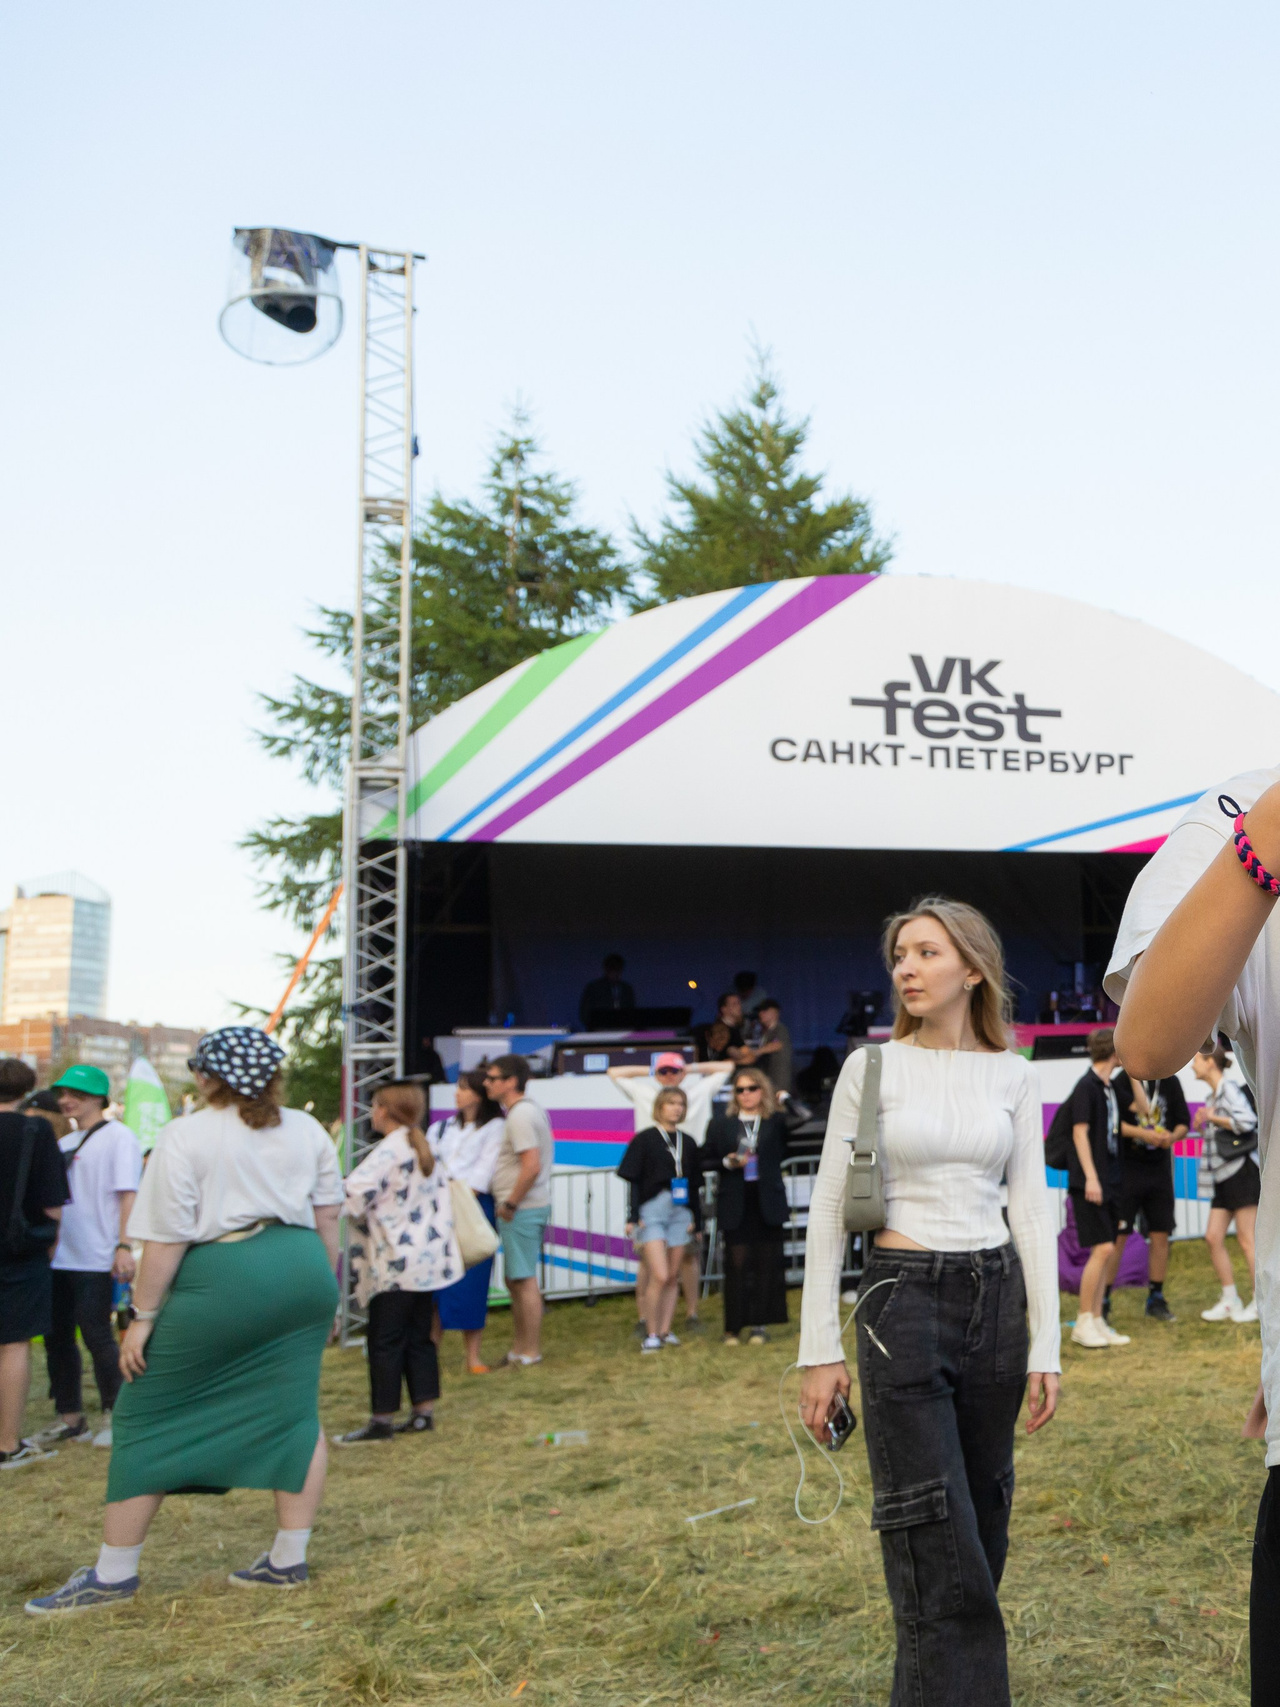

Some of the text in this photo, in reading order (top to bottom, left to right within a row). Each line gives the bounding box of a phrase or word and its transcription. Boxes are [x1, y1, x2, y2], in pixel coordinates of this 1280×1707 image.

[910, 653, 1004, 697] VK
[850, 680, 1062, 743] fest
[769, 738, 1134, 776] САНКТ-ПЕТЕРБУРГ
